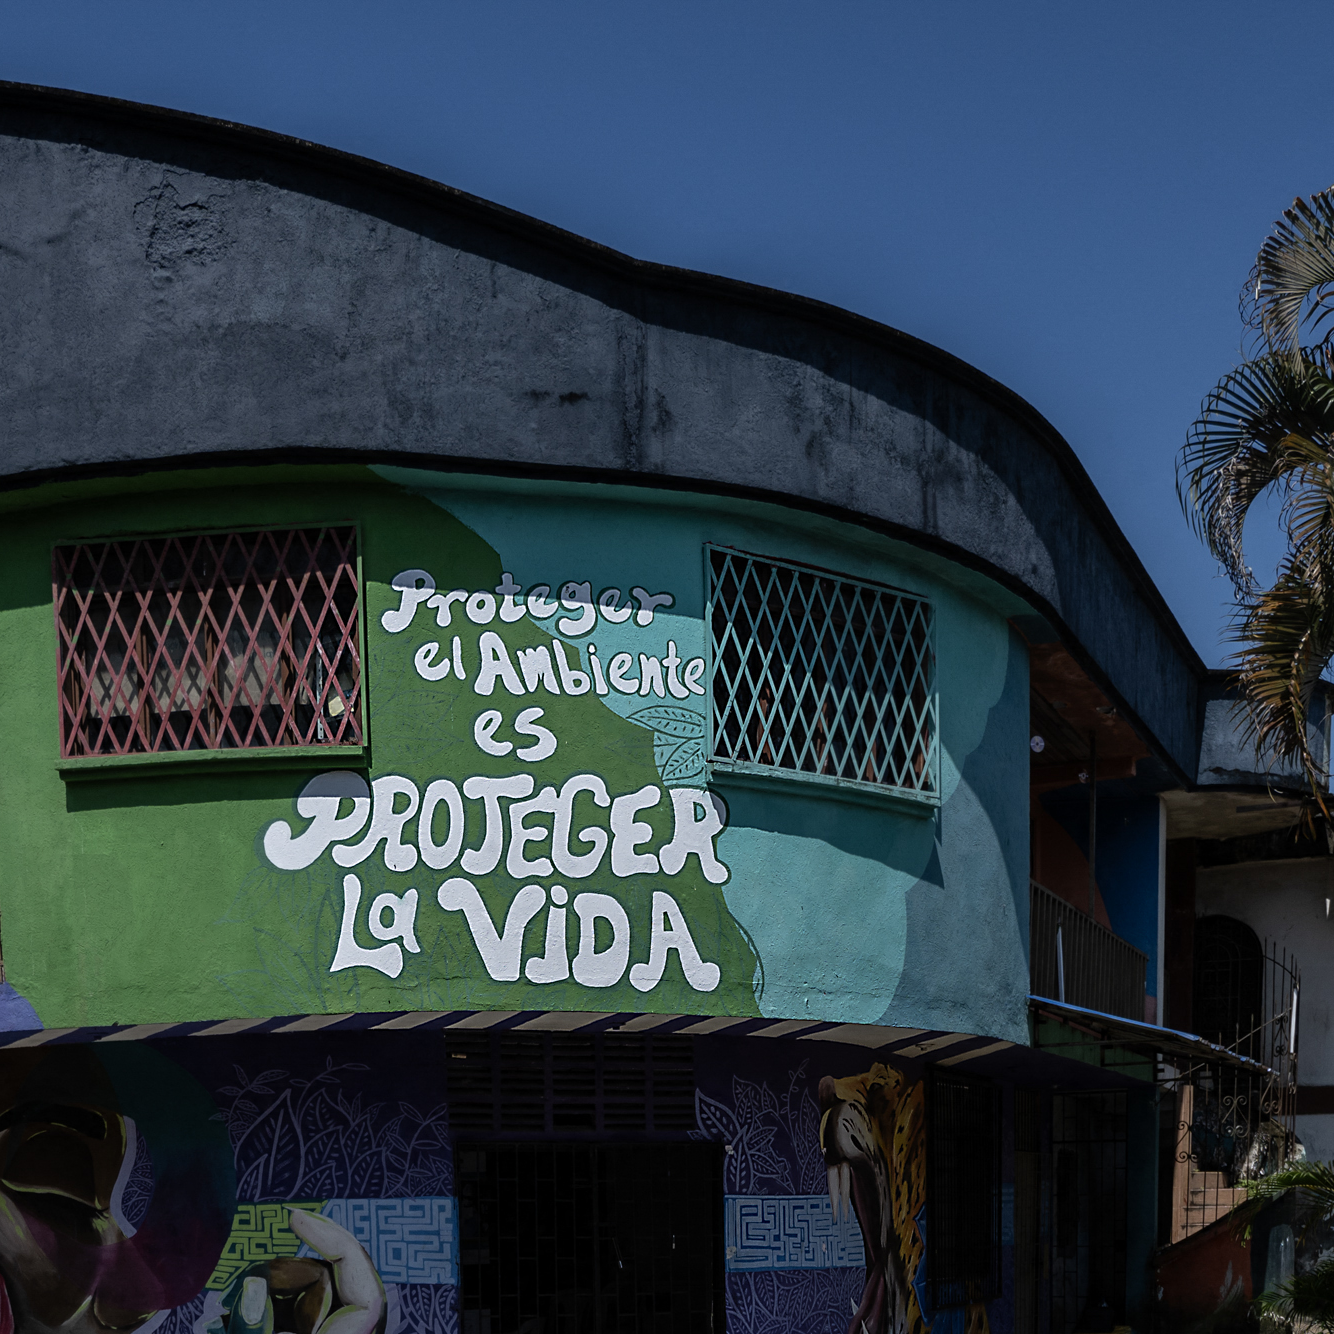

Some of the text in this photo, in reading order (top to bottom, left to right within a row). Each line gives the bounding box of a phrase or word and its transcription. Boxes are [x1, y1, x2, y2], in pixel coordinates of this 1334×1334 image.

[381, 568, 675, 636] Proteger
[414, 630, 706, 699] el Ambiente
[474, 707, 558, 762] es
[264, 770, 730, 884] PROTEGER
[329, 873, 421, 979] La
